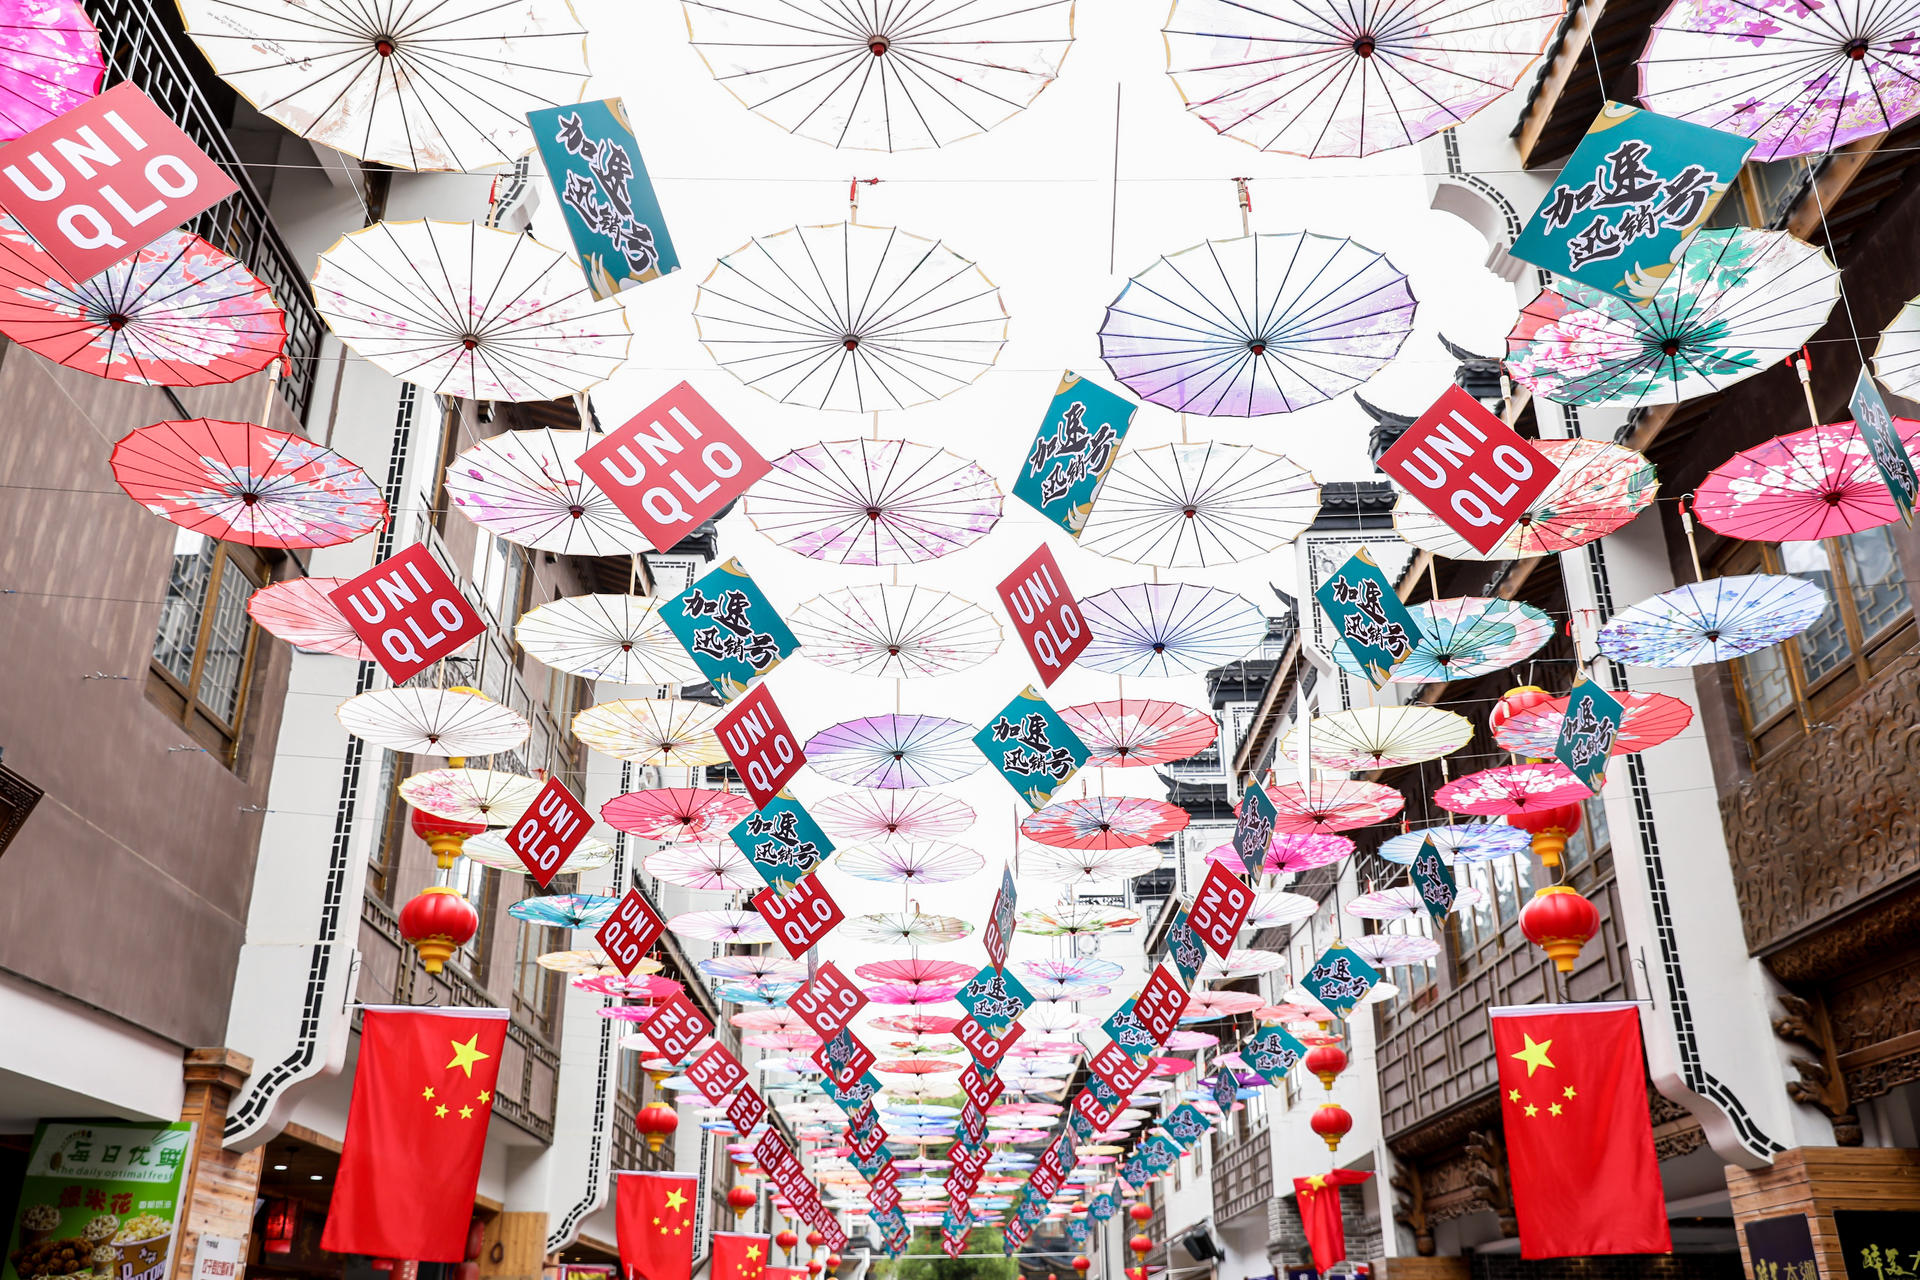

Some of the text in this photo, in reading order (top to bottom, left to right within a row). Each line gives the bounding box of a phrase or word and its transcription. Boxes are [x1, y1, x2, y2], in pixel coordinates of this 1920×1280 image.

[2, 108, 149, 203] UNI
[56, 153, 198, 250] QLO
[1540, 139, 1666, 236] 加速
[600, 405, 703, 488] UNI
[1029, 401, 1091, 478] 加速
[1400, 408, 1488, 491] UNI
[640, 440, 743, 526] QLO
[1450, 443, 1534, 528] QLO
[347, 560, 434, 625] UNI
[681, 587, 754, 637] 加速
[1010, 563, 1062, 627] UNI
[1331, 575, 1386, 626] 加速
[380, 598, 465, 665] QLO
[1033, 603, 1081, 669] QLO
[726, 699, 776, 758] UNI
[991, 712, 1052, 753] 加速
[746, 733, 794, 793] QLO
[537, 788, 581, 842] UNI
[745, 810, 800, 847] 加速
[517, 817, 561, 872] QLO
[620, 897, 655, 943] UNI
[783, 895, 833, 946] QLO
[1193, 875, 1228, 930] UNI
[1211, 888, 1245, 946] QLO
[602, 920, 640, 966] QLO
[987, 922, 1005, 964] QLO
[966, 975, 1010, 1002] 加速
[1312, 956, 1353, 983] 加速
[796, 972, 840, 1014] UNI
[816, 988, 858, 1031] QLO
[1138, 975, 1174, 1019] UNI
[1157, 989, 1183, 1035] QLO
[647, 1001, 688, 1040] UNI
[664, 1015, 704, 1056] QLO
[961, 1019, 1000, 1059] QLO
[691, 1049, 727, 1083] UNI
[705, 1062, 741, 1098] QLO
[1096, 1046, 1127, 1076] UN
[1112, 1059, 1149, 1091] QLO
[730, 1090, 753, 1121] UNI
[964, 1071, 990, 1107] QLO
[1079, 1093, 1111, 1126] QLO
[739, 1099, 762, 1132] QLO
[756, 1144, 777, 1170] QLO
[764, 1131, 783, 1156] UNI
[962, 1147, 988, 1174] QLO
[76, 1166, 102, 1178] daily
[104, 1169, 147, 1180] optimal
[771, 1166, 790, 1185] LO
[792, 1173, 813, 1197] UNI
[946, 1179, 967, 1202] QLO
[1032, 1166, 1050, 1186] UN
[783, 1183, 805, 1206] QLO
